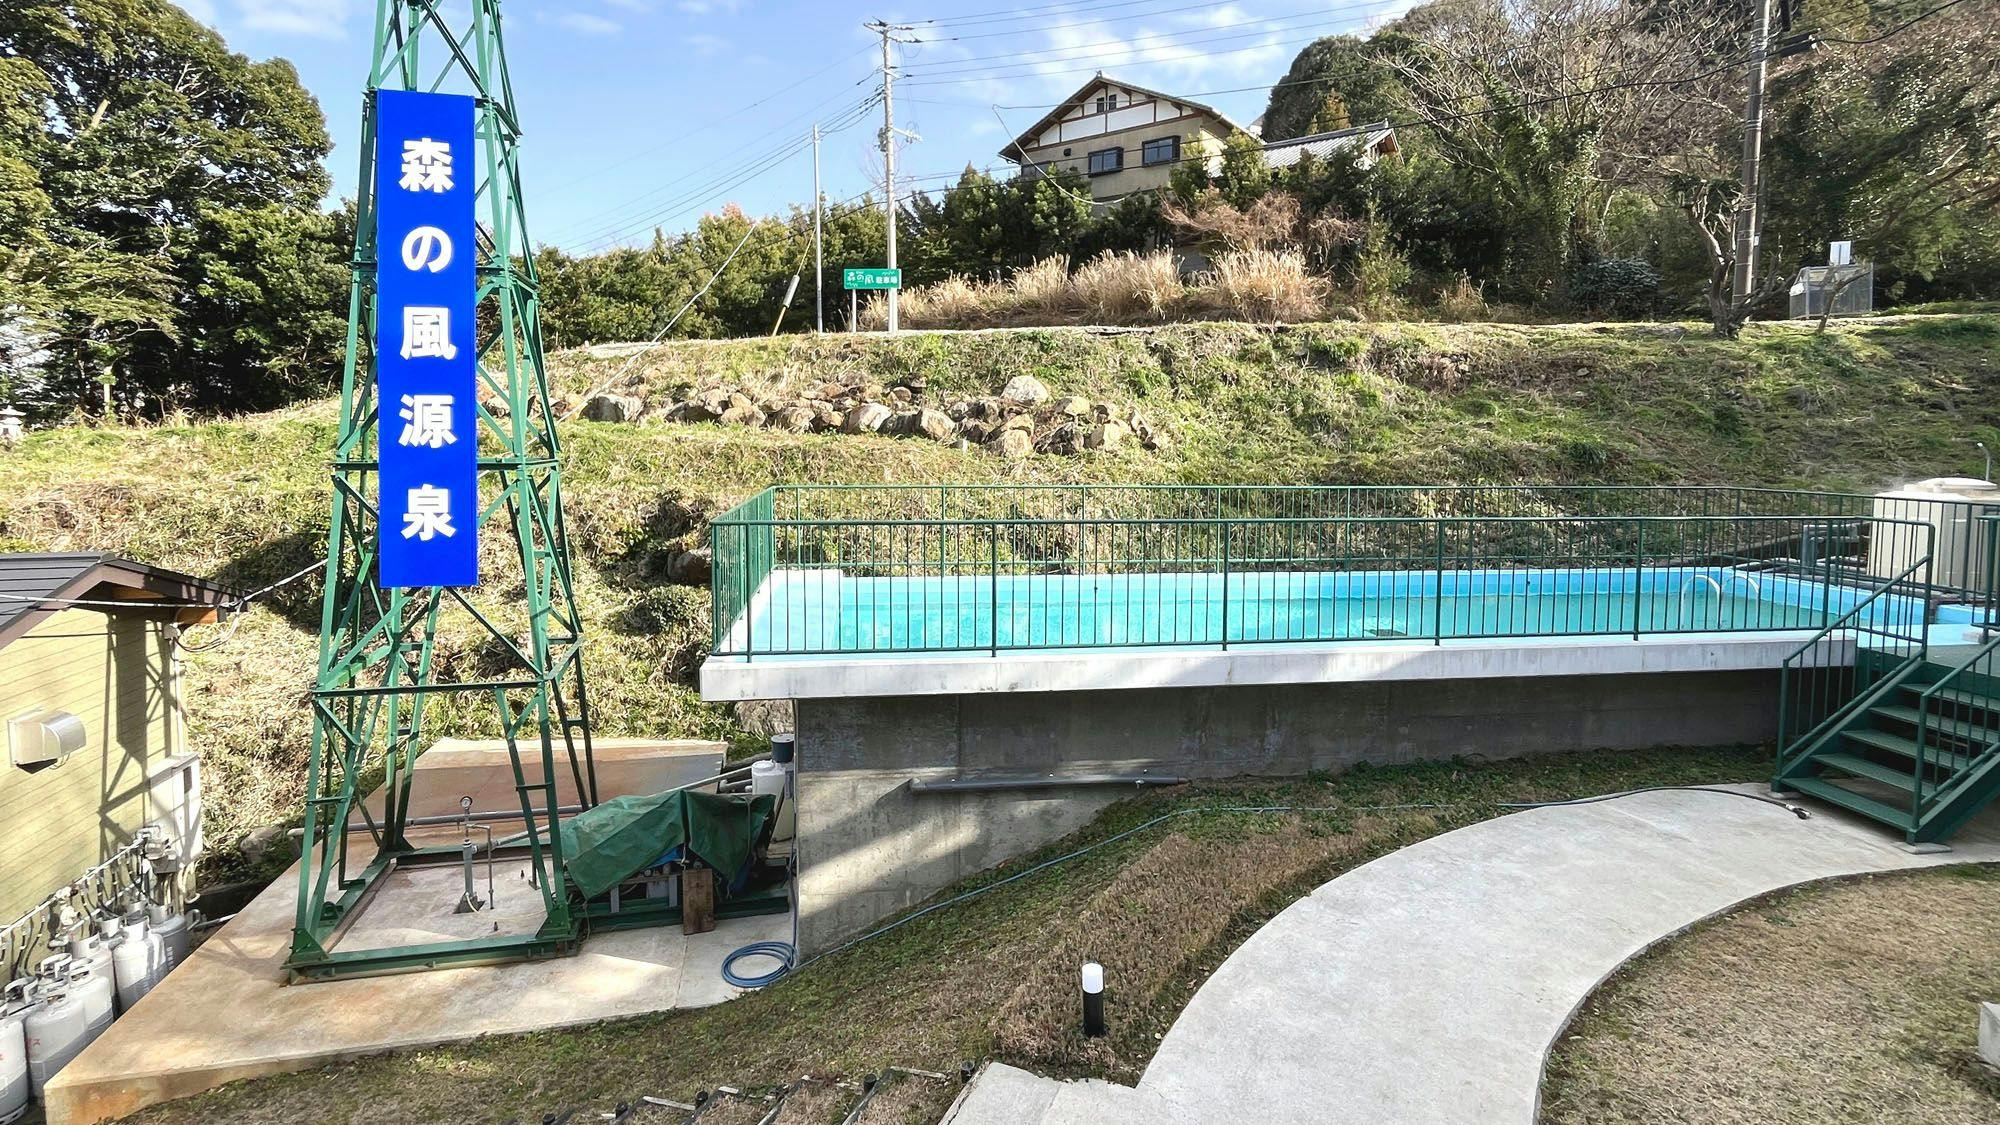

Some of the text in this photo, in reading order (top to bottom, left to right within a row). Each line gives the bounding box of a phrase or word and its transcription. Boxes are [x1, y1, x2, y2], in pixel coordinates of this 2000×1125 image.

[398, 137, 457, 541] 森の風源泉
